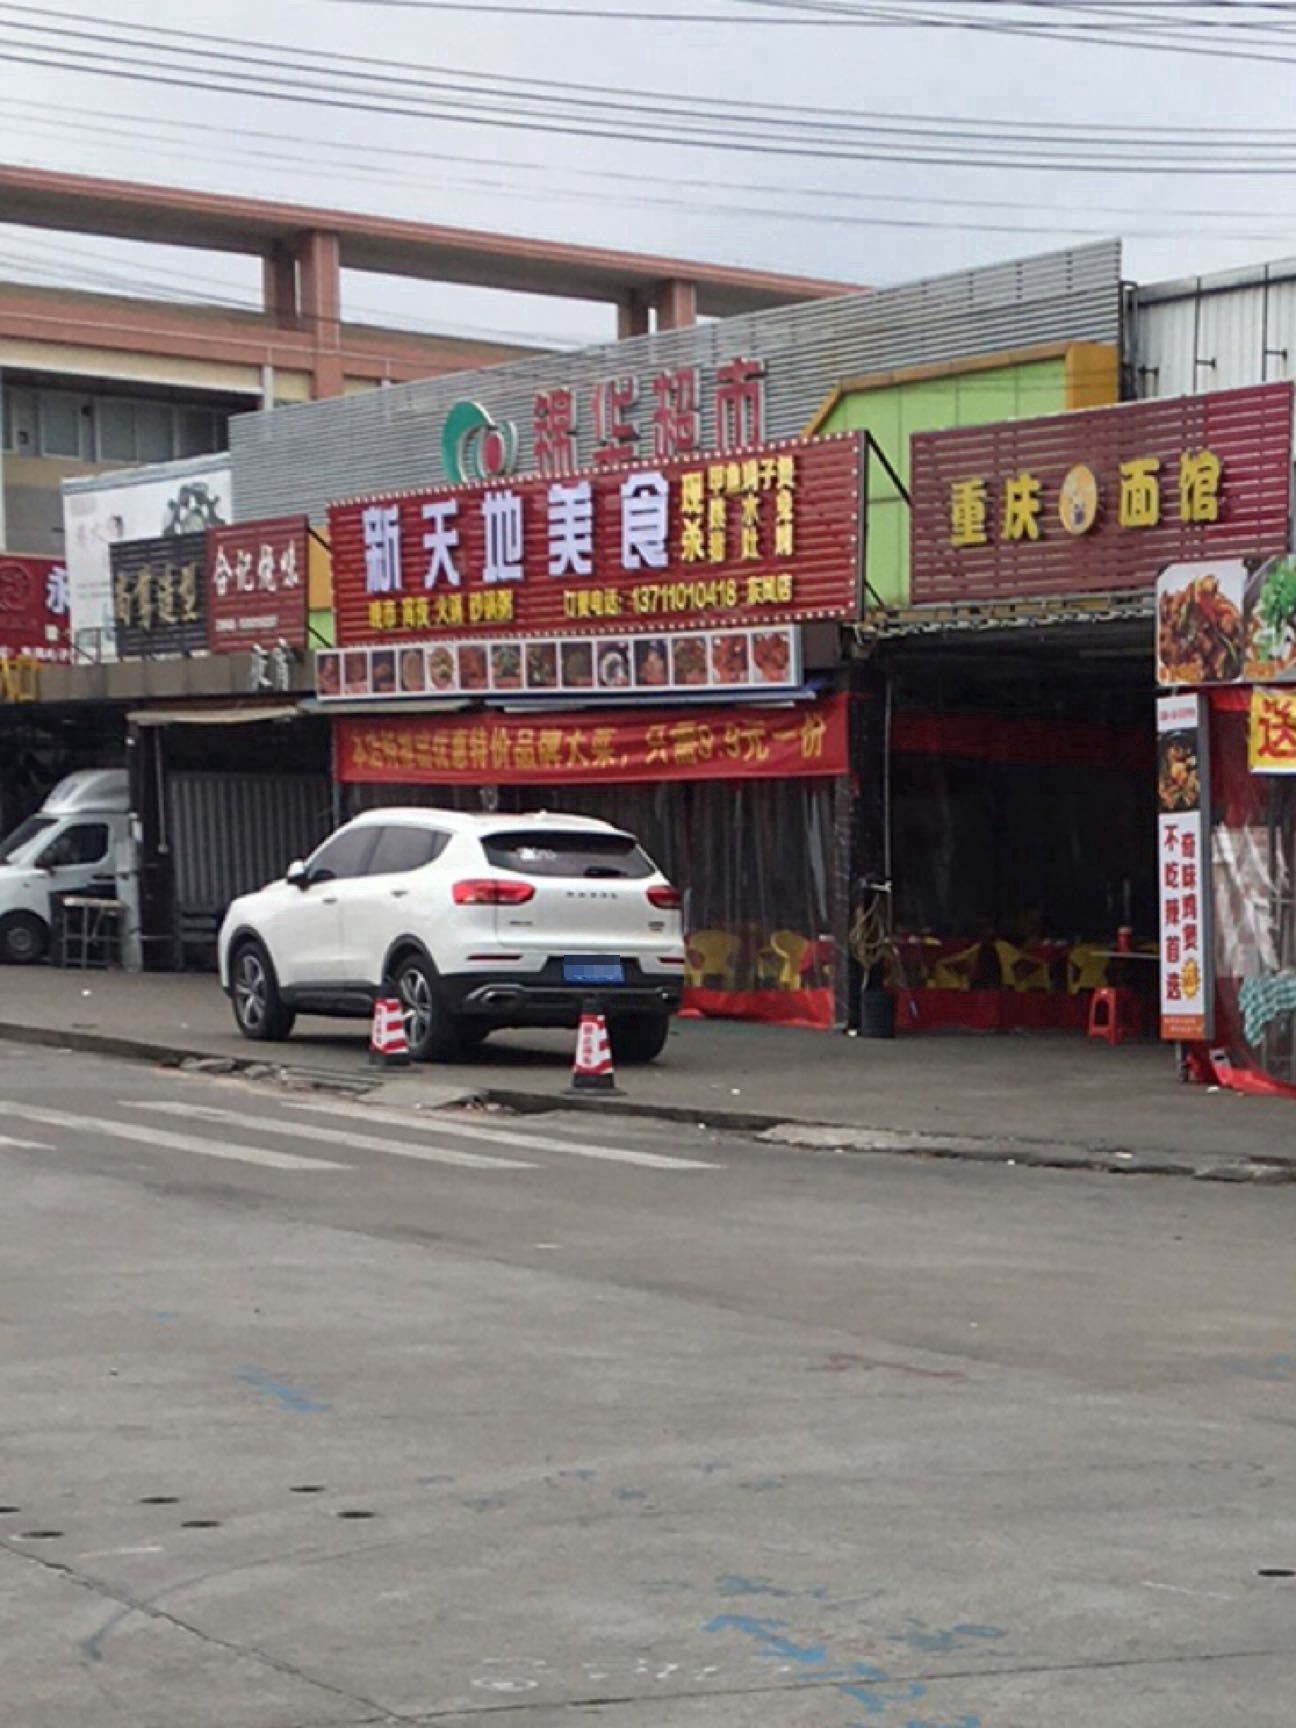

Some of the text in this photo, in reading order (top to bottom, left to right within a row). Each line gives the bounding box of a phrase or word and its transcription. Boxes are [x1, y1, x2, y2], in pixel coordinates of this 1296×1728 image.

[361, 472, 669, 593] 新天地美食
[949, 450, 1222, 547] 重庆 面馆
